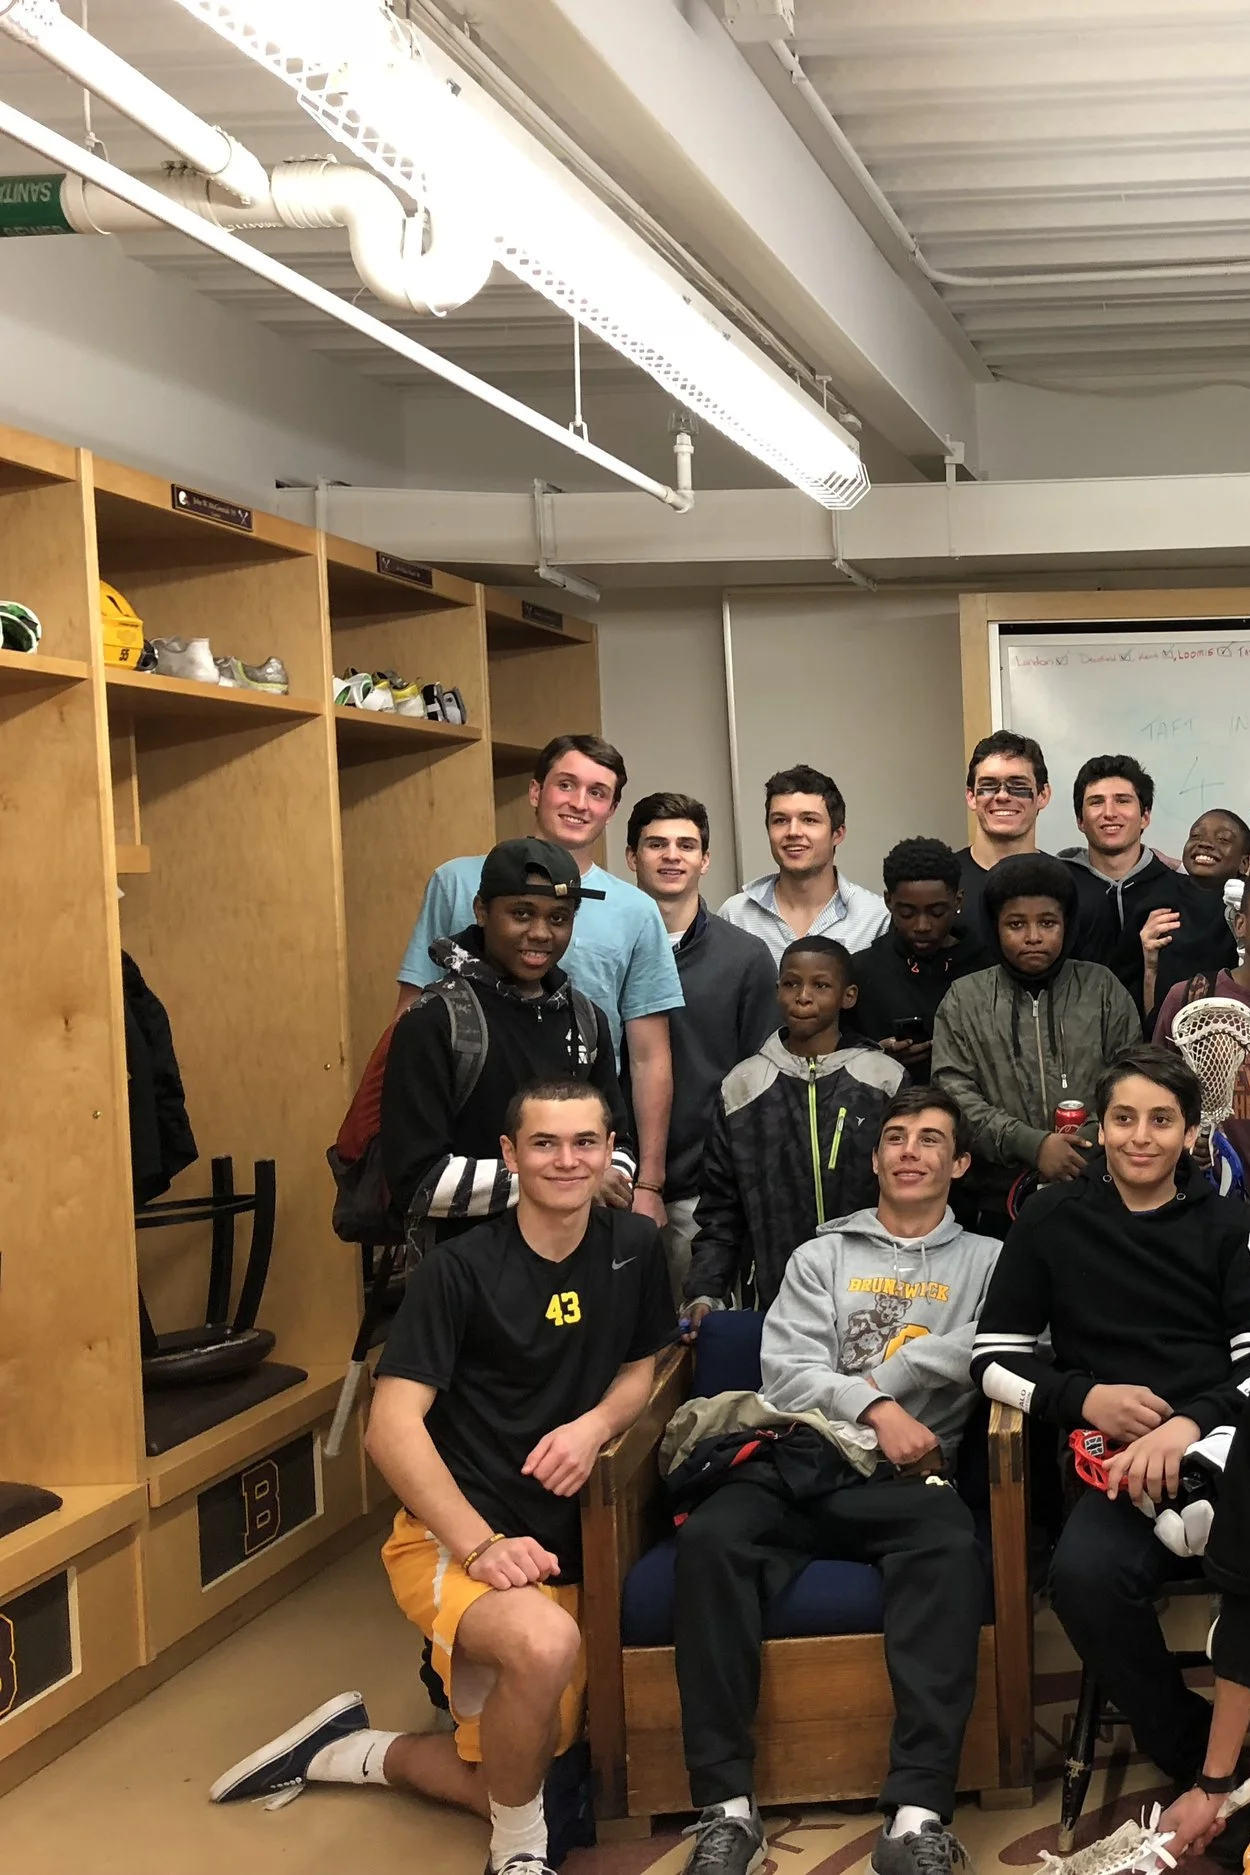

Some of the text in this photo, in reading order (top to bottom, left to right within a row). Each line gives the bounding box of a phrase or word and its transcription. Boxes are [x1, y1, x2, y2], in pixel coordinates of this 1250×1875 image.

[1140, 715, 1250, 741] TAFT IN
[545, 1291, 582, 1326] 43
[241, 1459, 281, 1555] B
